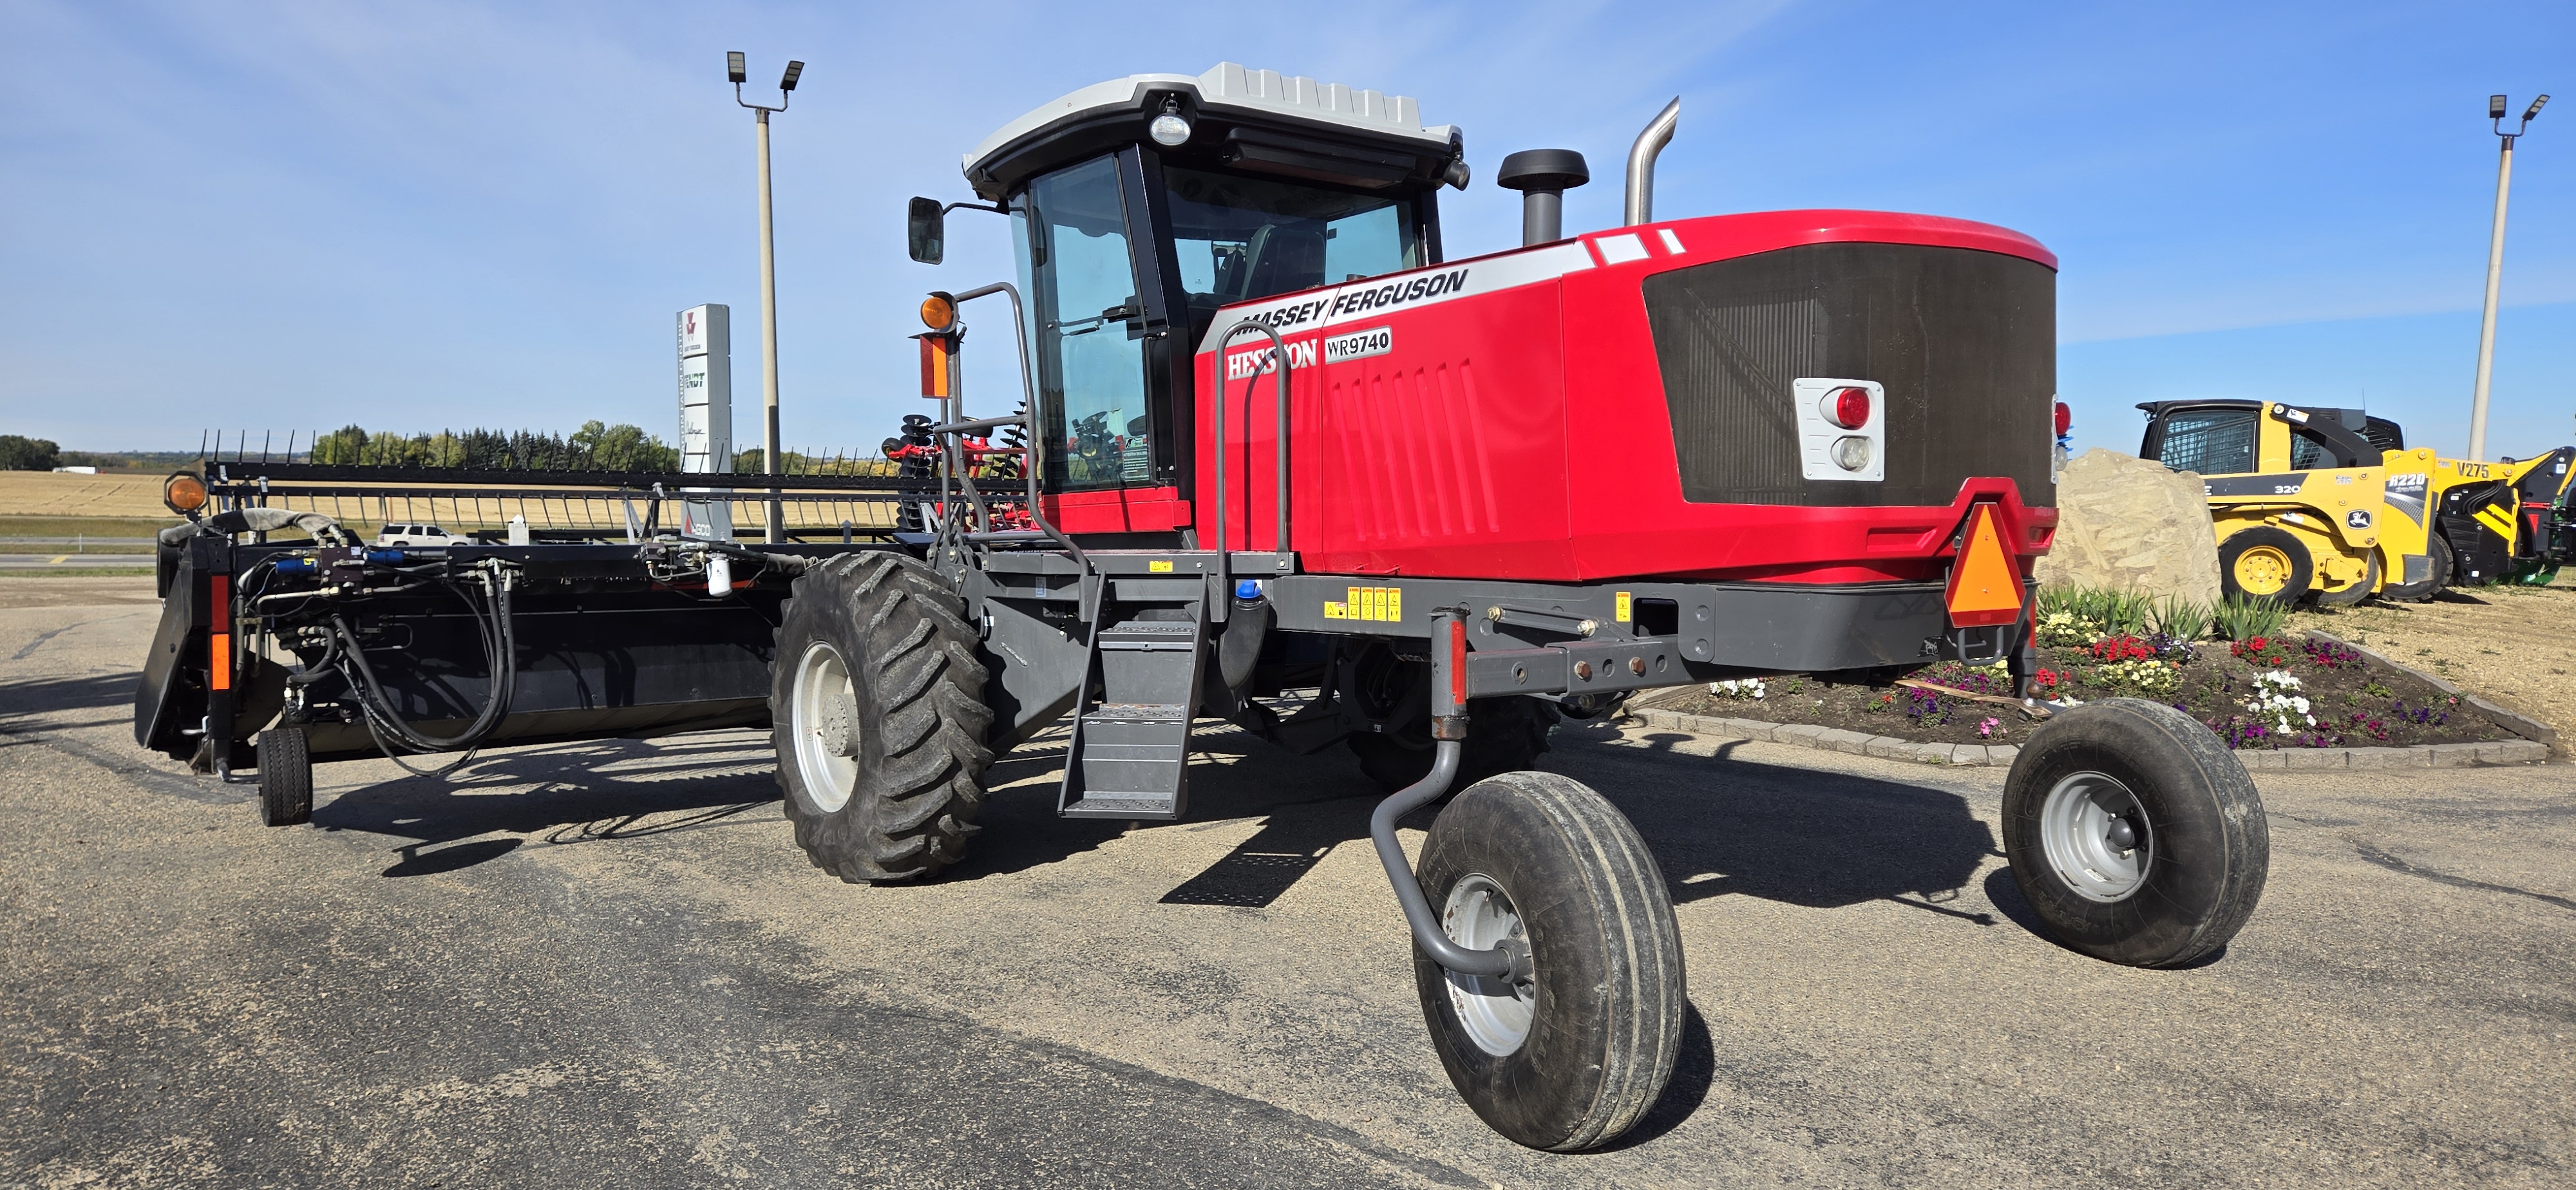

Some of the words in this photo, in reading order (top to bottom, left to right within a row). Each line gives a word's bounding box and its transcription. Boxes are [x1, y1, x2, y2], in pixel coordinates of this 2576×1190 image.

[1330, 269, 1469, 317] FERGUSON
[1327, 332, 1389, 357] WR9740
[1227, 339, 1317, 381] HESSON
[2389, 473, 2427, 487] R220
[2457, 462, 2489, 478] V275
[2275, 485, 2301, 494] 320
